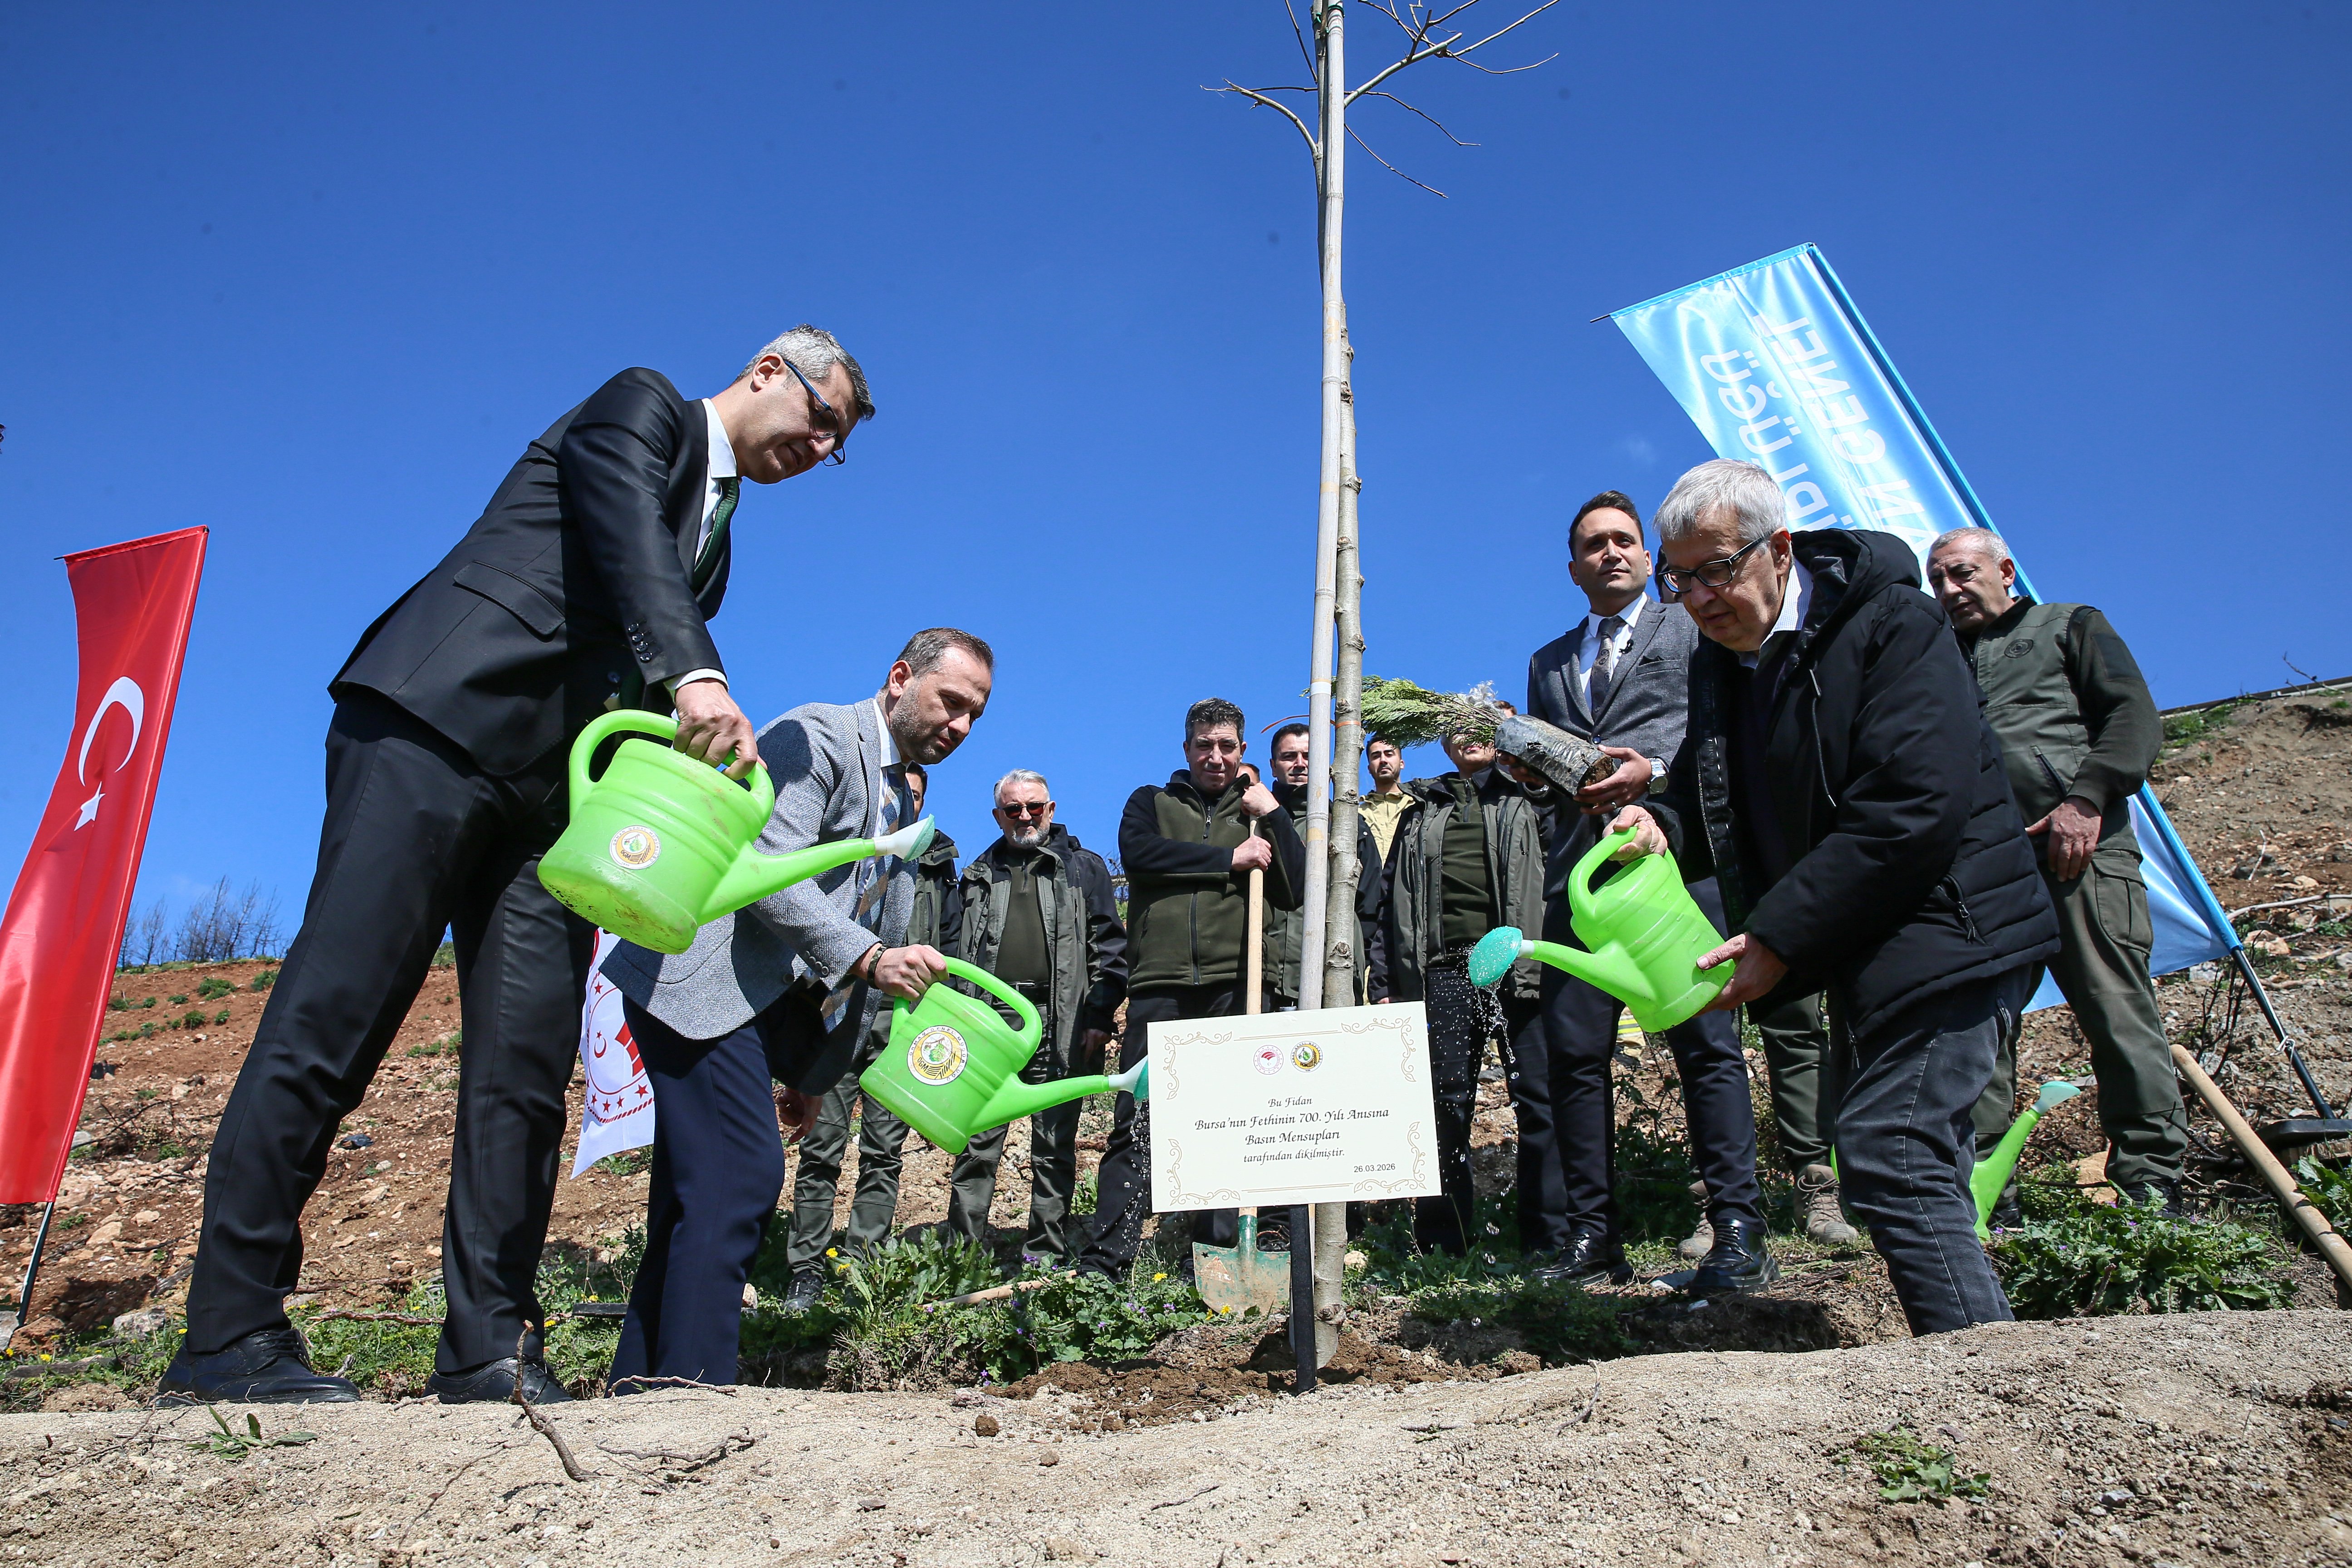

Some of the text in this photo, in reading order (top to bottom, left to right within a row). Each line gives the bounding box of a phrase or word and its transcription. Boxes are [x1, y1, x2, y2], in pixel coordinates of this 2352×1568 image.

[621, 849, 631, 860] OGM
[917, 1057, 929, 1072] OGM
[1268, 1096, 1312, 1107] Bu Fidan
[1250, 1114, 1296, 1128] Fethinin
[1300, 1112, 1322, 1123] 700.
[1324, 1109, 1345, 1123] Yılı
[1347, 1109, 1389, 1120] Anısına
[1245, 1128, 1340, 1145] Basın Mensupları
[1244, 1147, 1345, 1166] tarafından dikilmiştir.
[1354, 1163, 1396, 1172] 26.03.2026
